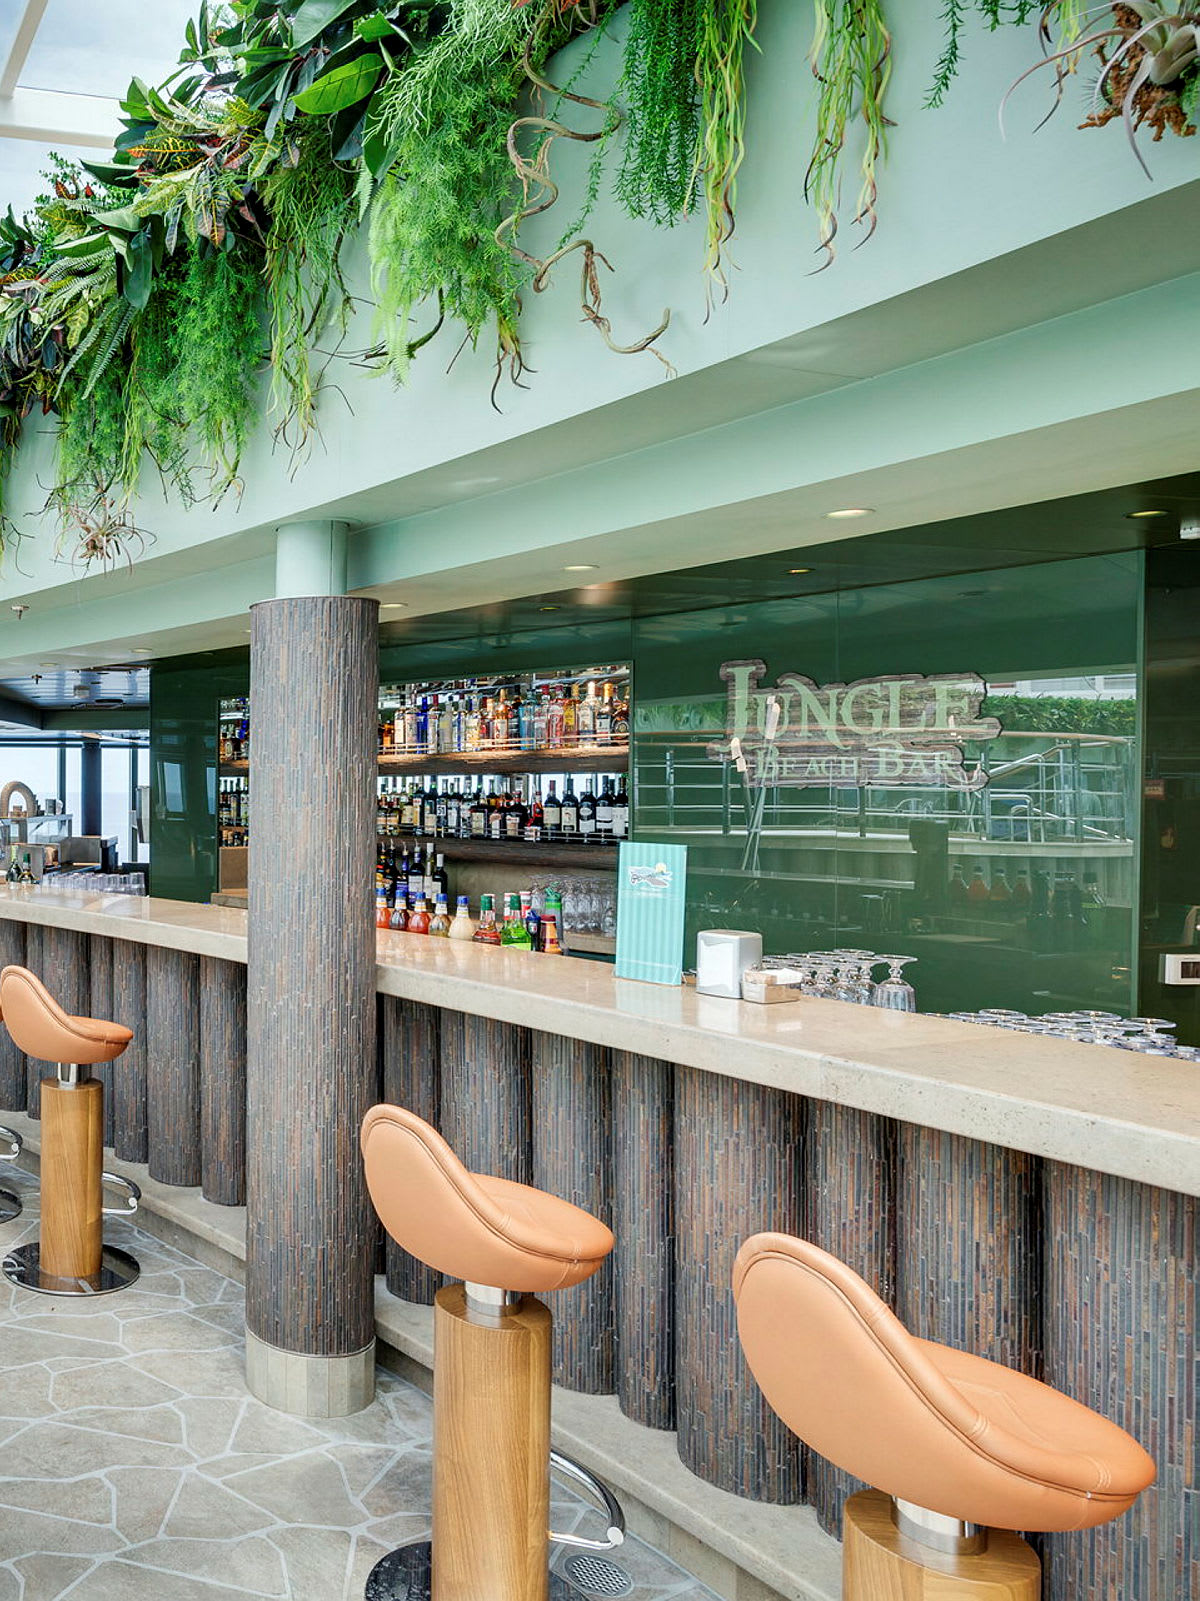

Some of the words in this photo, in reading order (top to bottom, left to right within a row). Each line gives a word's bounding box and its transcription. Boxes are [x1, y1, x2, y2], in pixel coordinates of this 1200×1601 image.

[713, 665, 988, 750] JUNGLE
[746, 744, 861, 778] BEACH
[864, 740, 978, 783] BAR
